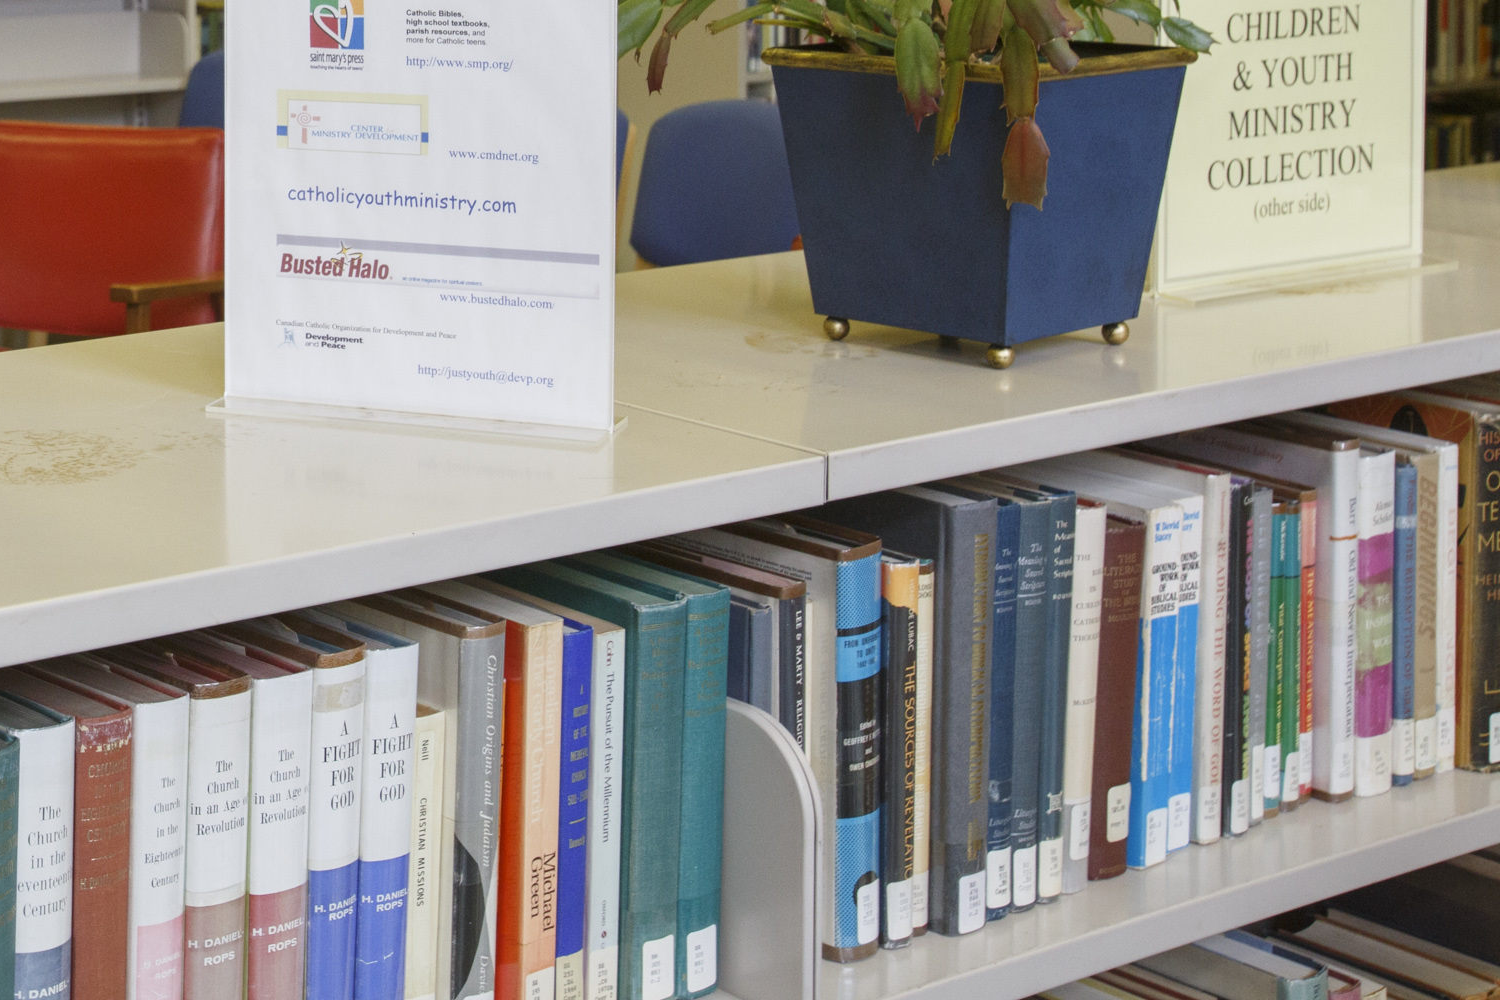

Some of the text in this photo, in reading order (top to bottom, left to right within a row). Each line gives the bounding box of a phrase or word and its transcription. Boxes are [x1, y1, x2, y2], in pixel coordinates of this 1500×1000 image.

[405, 9, 464, 18] Catholic Bibles,
[406, 18, 490, 28] high school textbooks,
[431, 29, 470, 37] resources,
[1227, 4, 1361, 44] CHILDREN
[436, 37, 465, 45] Catholic
[466, 38, 487, 46] teens.
[310, 51, 364, 66] saint mary's press
[406, 56, 514, 72] http://www.smp.org/
[1232, 52, 1353, 92] & YOUTH
[350, 125, 383, 133] CENTER
[1228, 98, 1357, 141] MINISTRY
[311, 130, 419, 142] MINISTRY DEVELOPMENT
[449, 149, 539, 164] www.cmdnet.org
[1207, 143, 1375, 191] COLLECTION
[287, 186, 517, 216] catholicyouthministry.com
[1253, 190, 1331, 223] (other side)
[280, 253, 390, 280] Busted Halo
[440, 293, 554, 310] www.bustedhalo.com/
[275, 318, 304, 327] Canadian
[305, 321, 331, 330] Catholic
[331, 323, 371, 333] Organization
[383, 327, 424, 338] Development
[438, 331, 457, 340] Peace
[305, 332, 363, 344] Development
[305, 340, 346, 350] and Peace
[417, 364, 554, 387] http://justyouth@devp.org
[1162, 520, 1180, 531] David
[1160, 571, 1179, 582] WORK
[1151, 592, 1178, 606] BIBLICAL
[1151, 602, 1175, 616] STUDIES
[795, 610, 803, 630] LEE
[1211, 541, 1227, 748] READING THE WORD OF
[795, 645, 803, 685] MARTY
[322, 738, 361, 763] FIGHT
[372, 732, 413, 755] FIGHT
[602, 640, 615, 843] Cohn The Pursuit of the Millennium
[903, 622, 916, 881] LUBAC THE SOURCES OF REVELATIO
[278, 749, 295, 762] The
[479, 654, 497, 868] Christian Origins and Judaism
[215, 760, 233, 774] The
[269, 766, 301, 784] Church
[330, 766, 355, 786] FOR
[379, 759, 405, 778] FOR
[161, 776, 176, 788] The
[207, 777, 239, 795] Church
[330, 790, 355, 811] GOD
[379, 783, 405, 803] GOD
[39, 806, 61, 822] The
[153, 797, 181, 814] Church
[260, 803, 307, 824] Revolution
[27, 825, 69, 847] Church
[156, 824, 179, 838] in the
[196, 816, 245, 837] Revolution
[31, 850, 66, 870] in the
[416, 797, 428, 908] CHRISTIAN MISSIONS
[151, 872, 180, 888] Century
[531, 856, 543, 919] Green
[542, 851, 556, 932] Michael
[22, 896, 68, 918] Century
